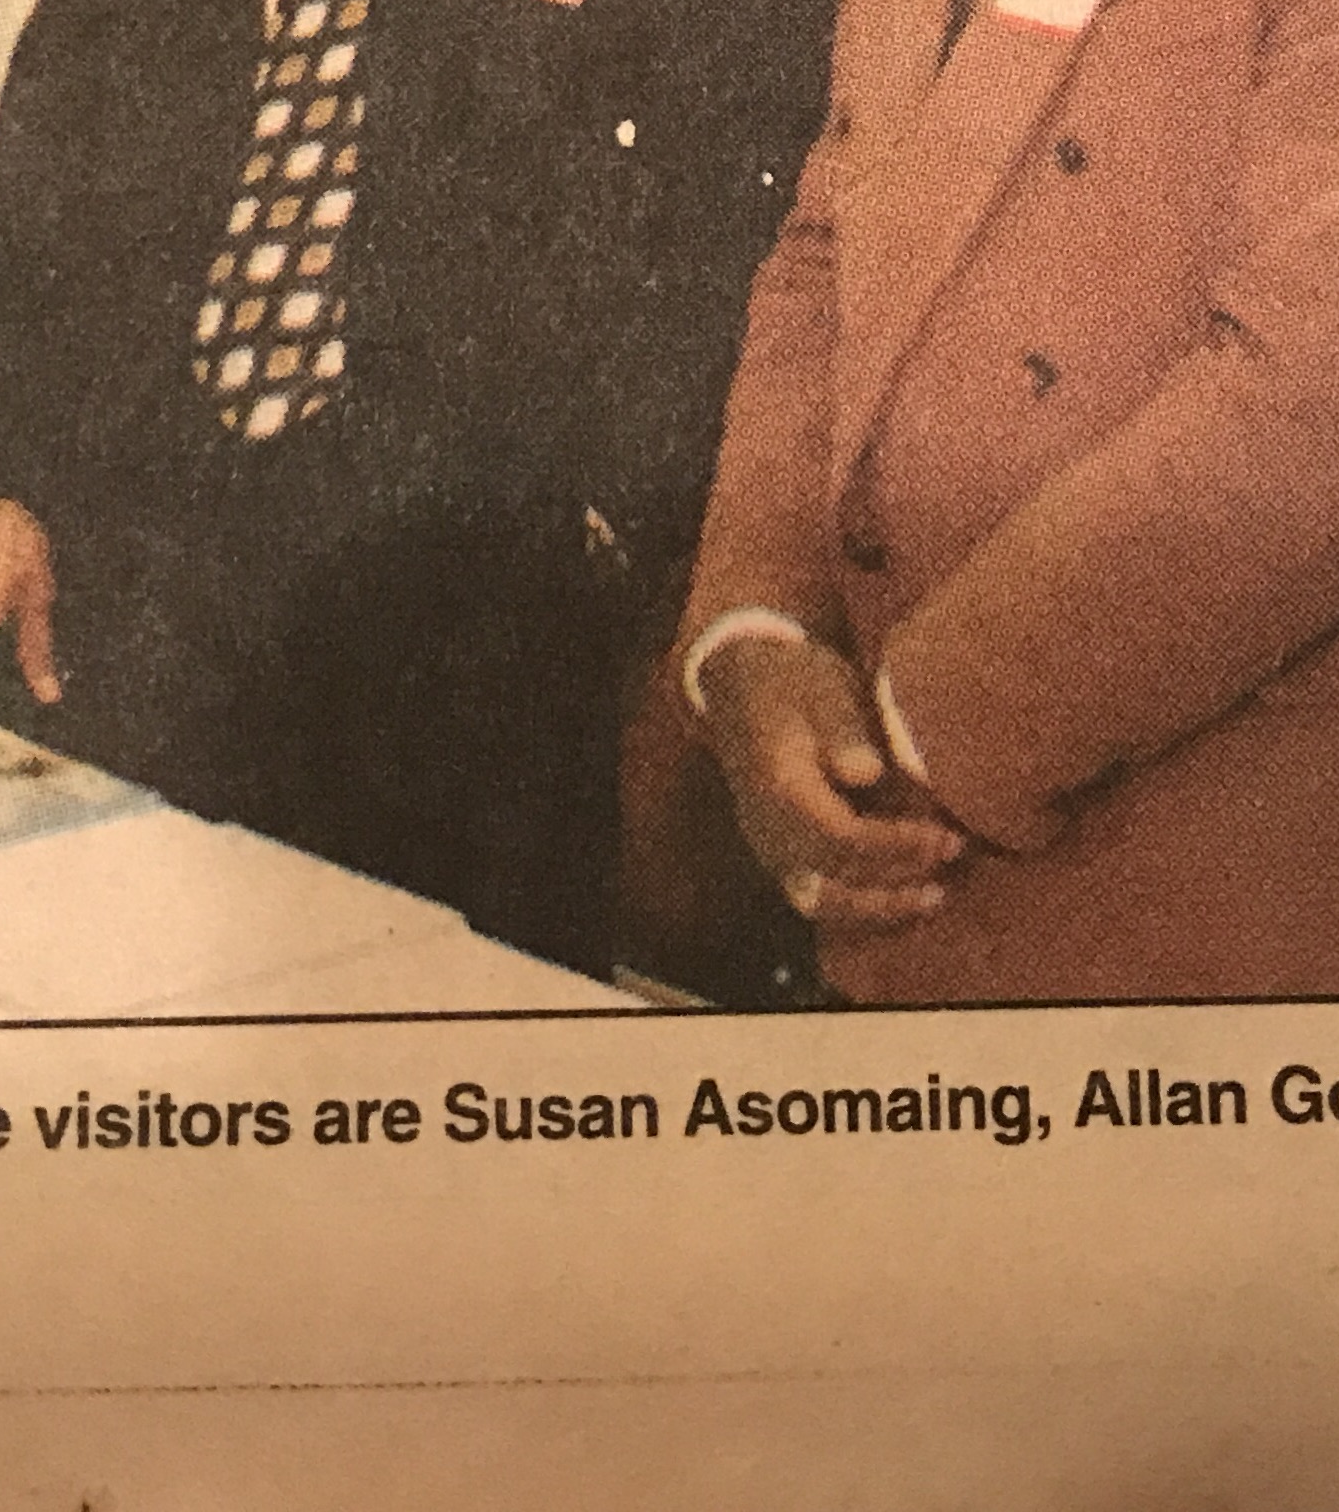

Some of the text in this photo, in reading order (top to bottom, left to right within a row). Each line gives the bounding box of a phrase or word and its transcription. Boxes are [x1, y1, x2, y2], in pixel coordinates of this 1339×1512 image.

[33, 1089, 292, 1151] visitors
[313, 1098, 422, 1146] are
[443, 1081, 660, 1144] Susan
[683, 1072, 1051, 1147] Asomaing,
[1074, 1068, 1248, 1129] Allan
